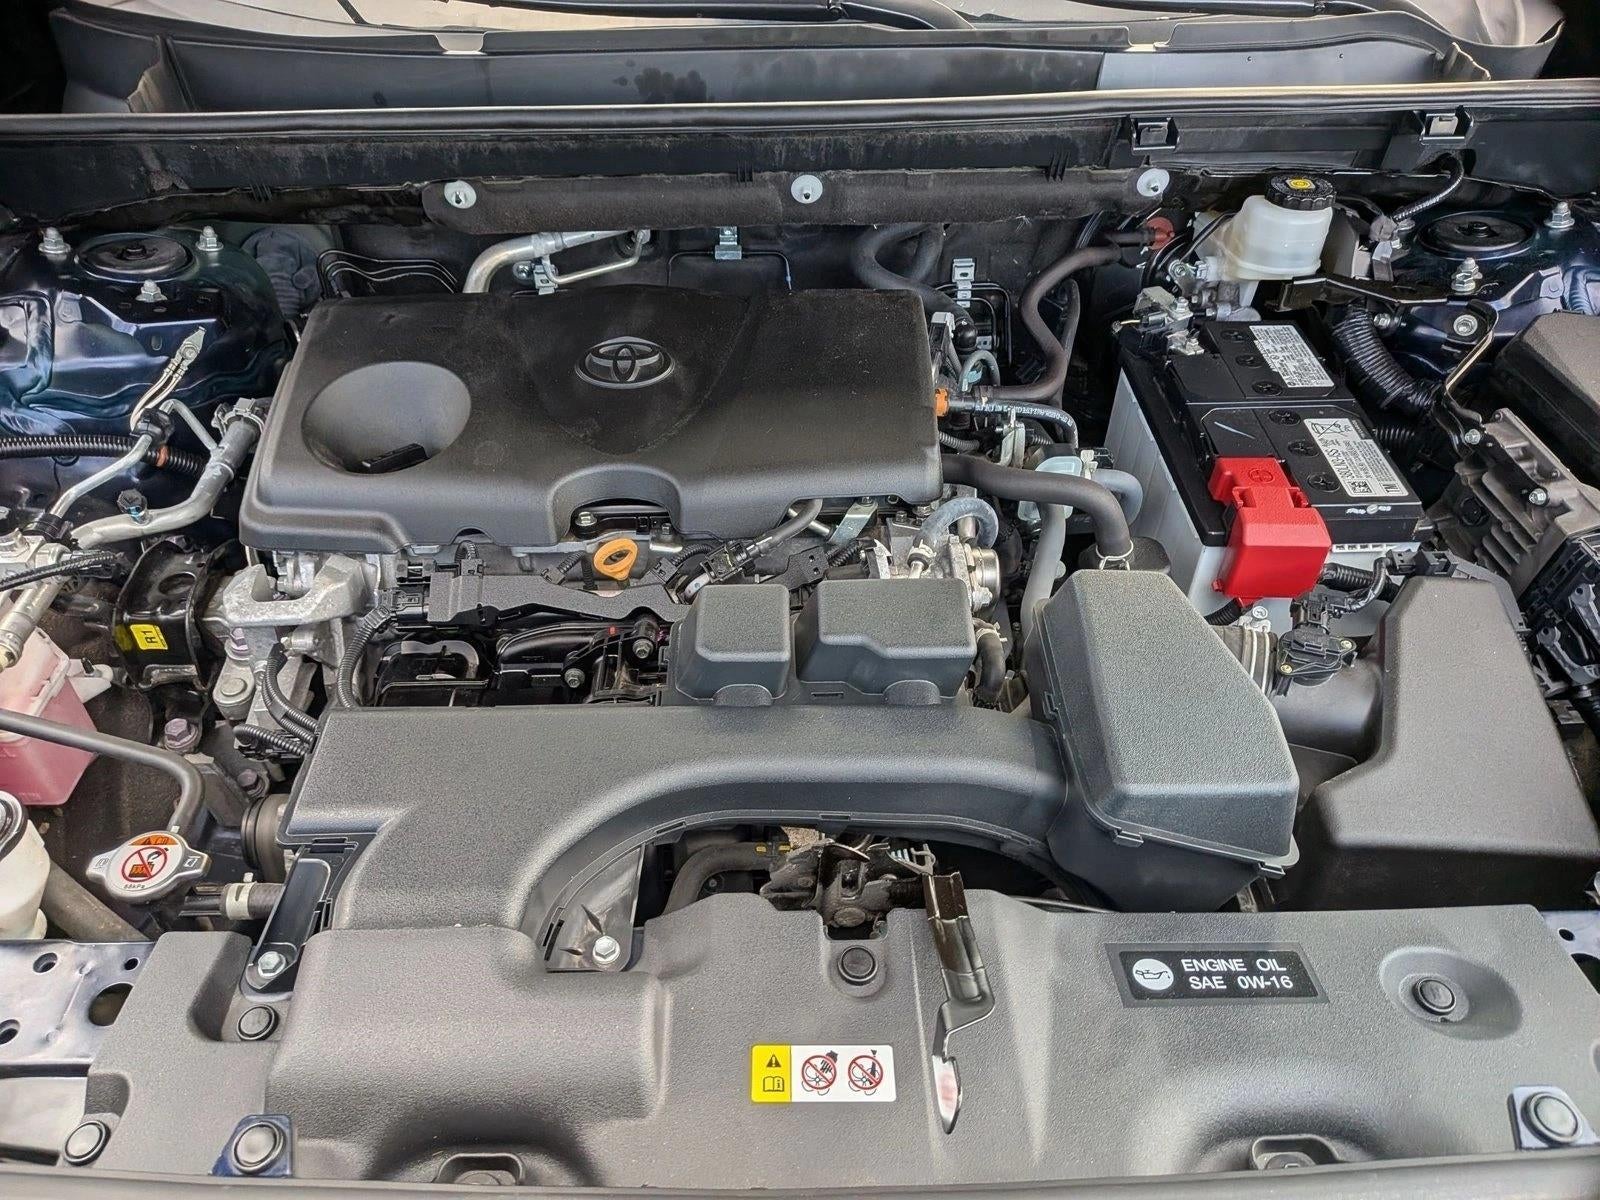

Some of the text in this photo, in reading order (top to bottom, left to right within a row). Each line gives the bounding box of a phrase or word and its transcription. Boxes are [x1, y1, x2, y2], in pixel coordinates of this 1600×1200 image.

[1181, 958, 1287, 972] ENGINE OIL
[1189, 976, 1293, 990] SAE 0W-16
